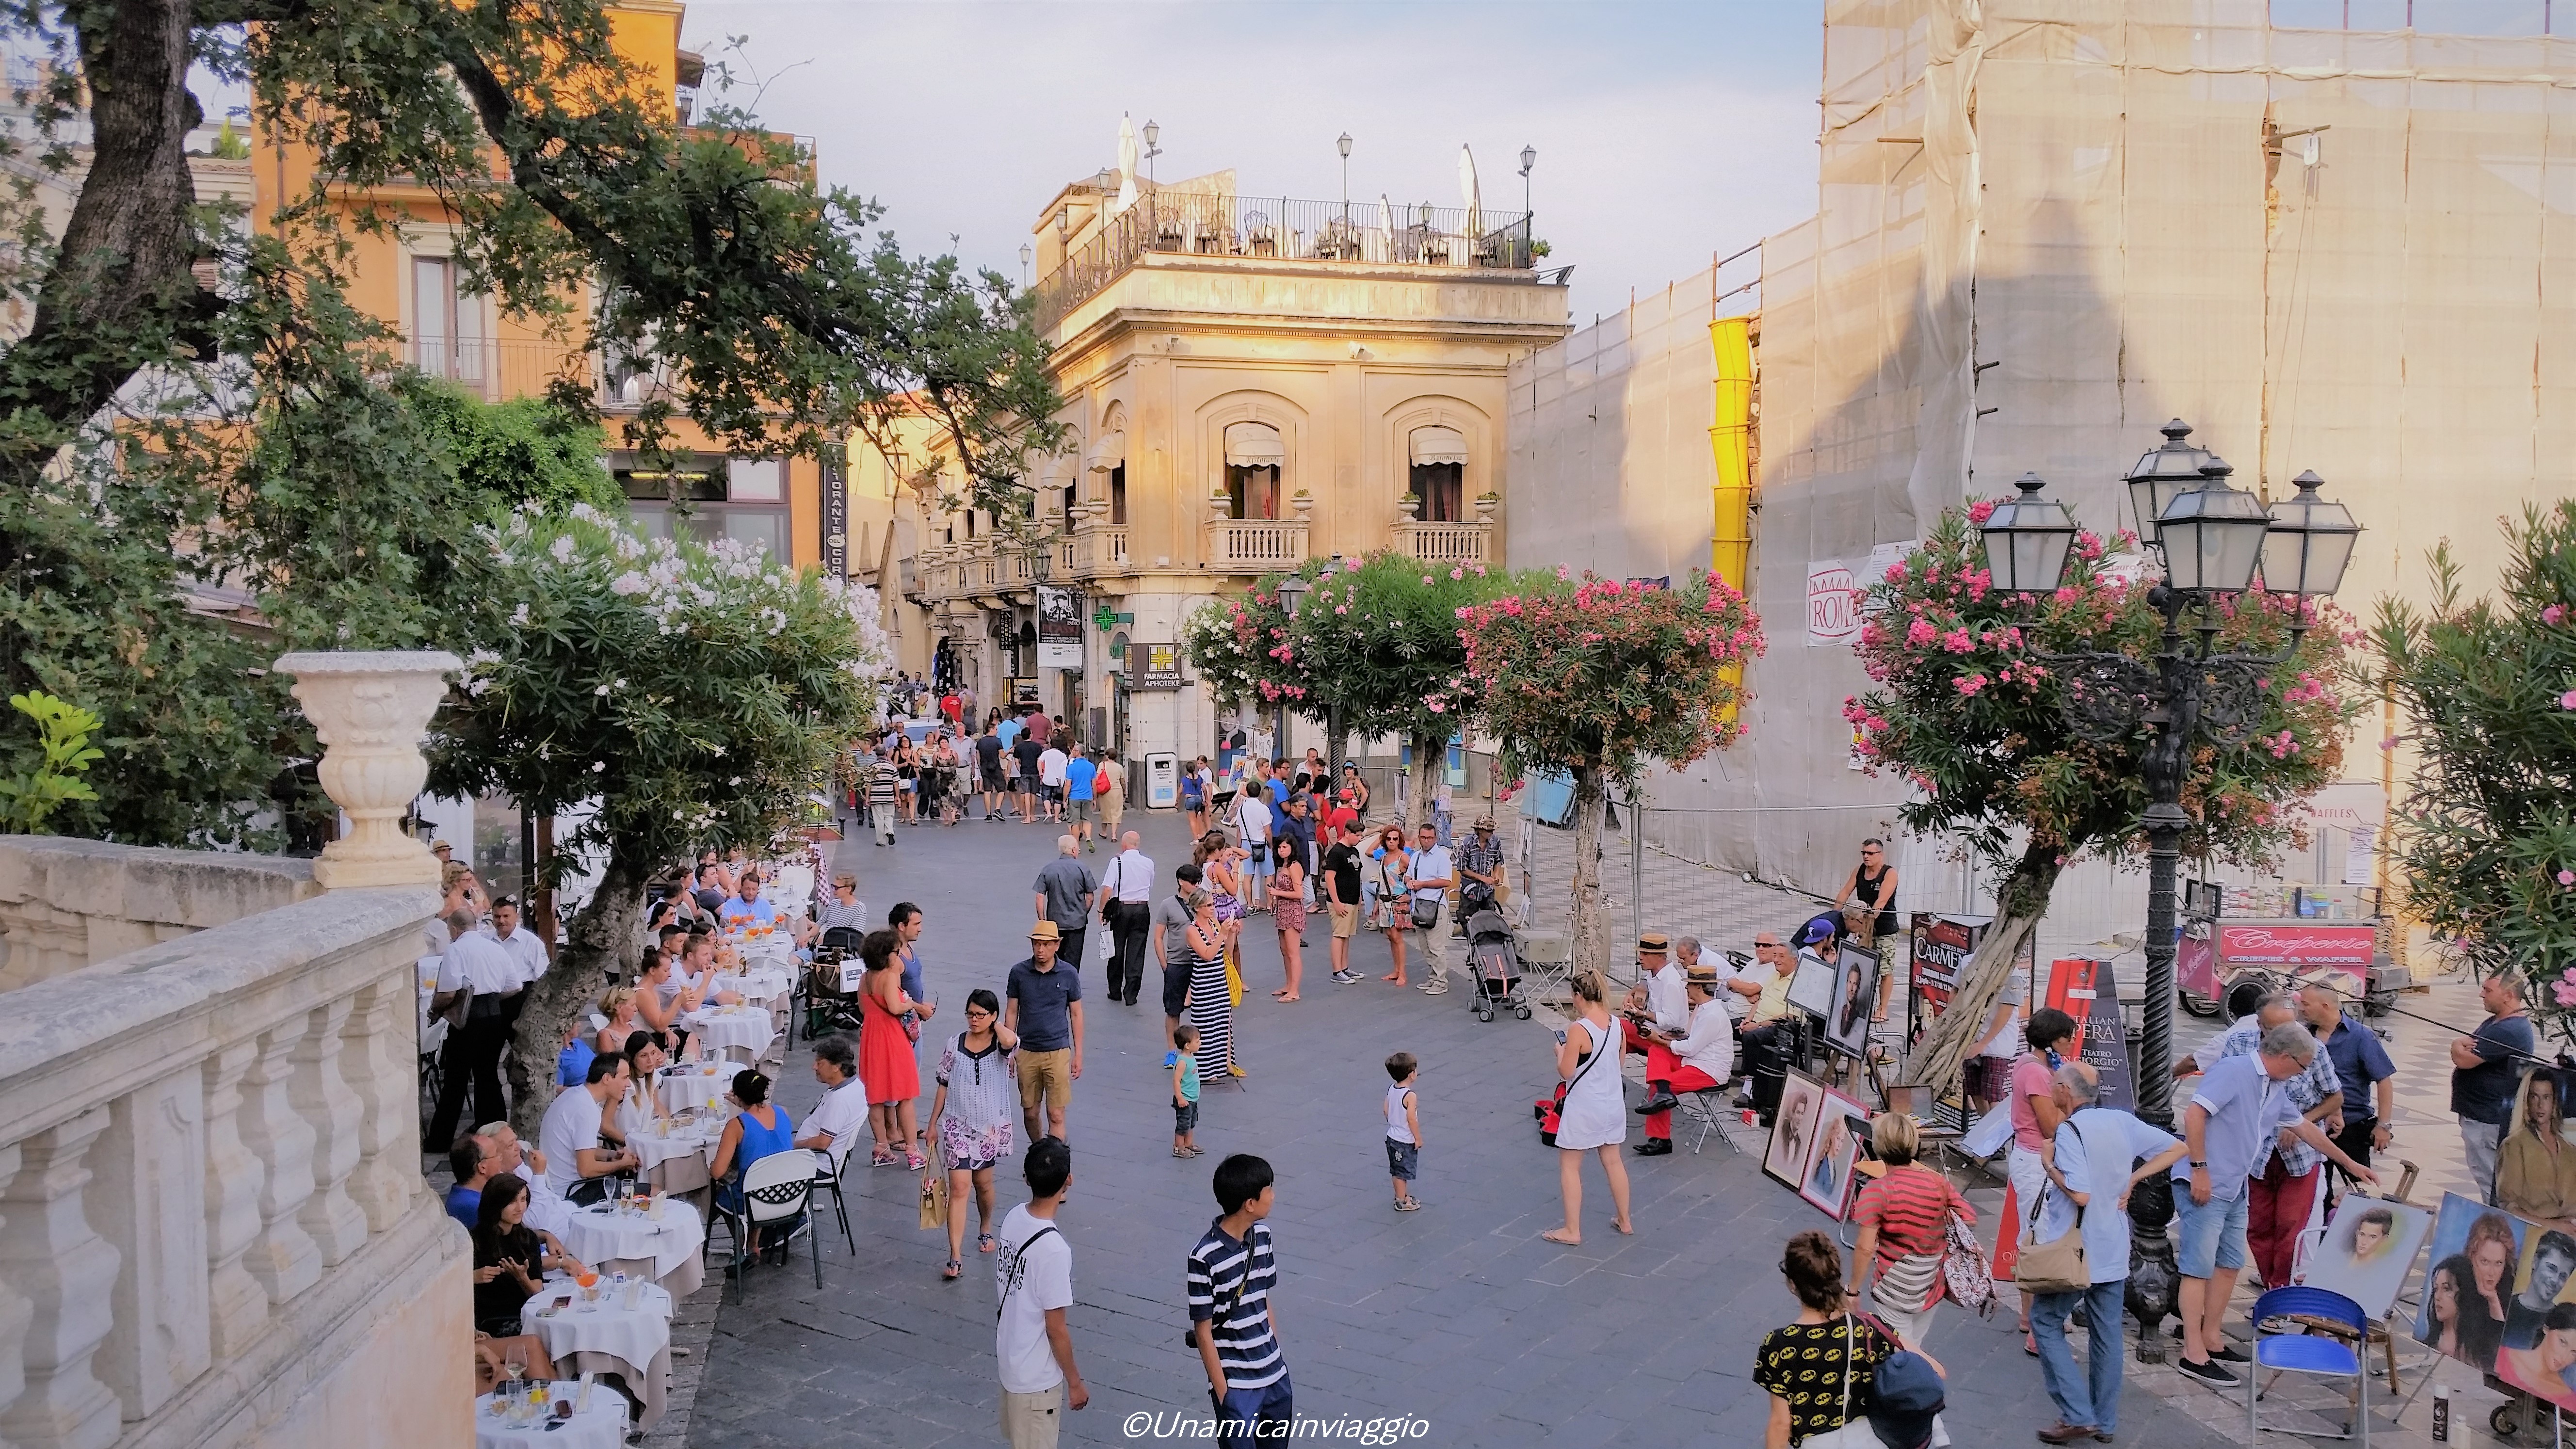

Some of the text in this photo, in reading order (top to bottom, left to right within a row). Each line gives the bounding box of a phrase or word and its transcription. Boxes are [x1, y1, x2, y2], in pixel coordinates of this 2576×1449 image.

[2311, 809, 2352, 818] WAFFLES
[2074, 1015, 2116, 1026] TALIAN
[2074, 1024, 2116, 1040] PERA
[2082, 1048, 2112, 1058] TEATRO
